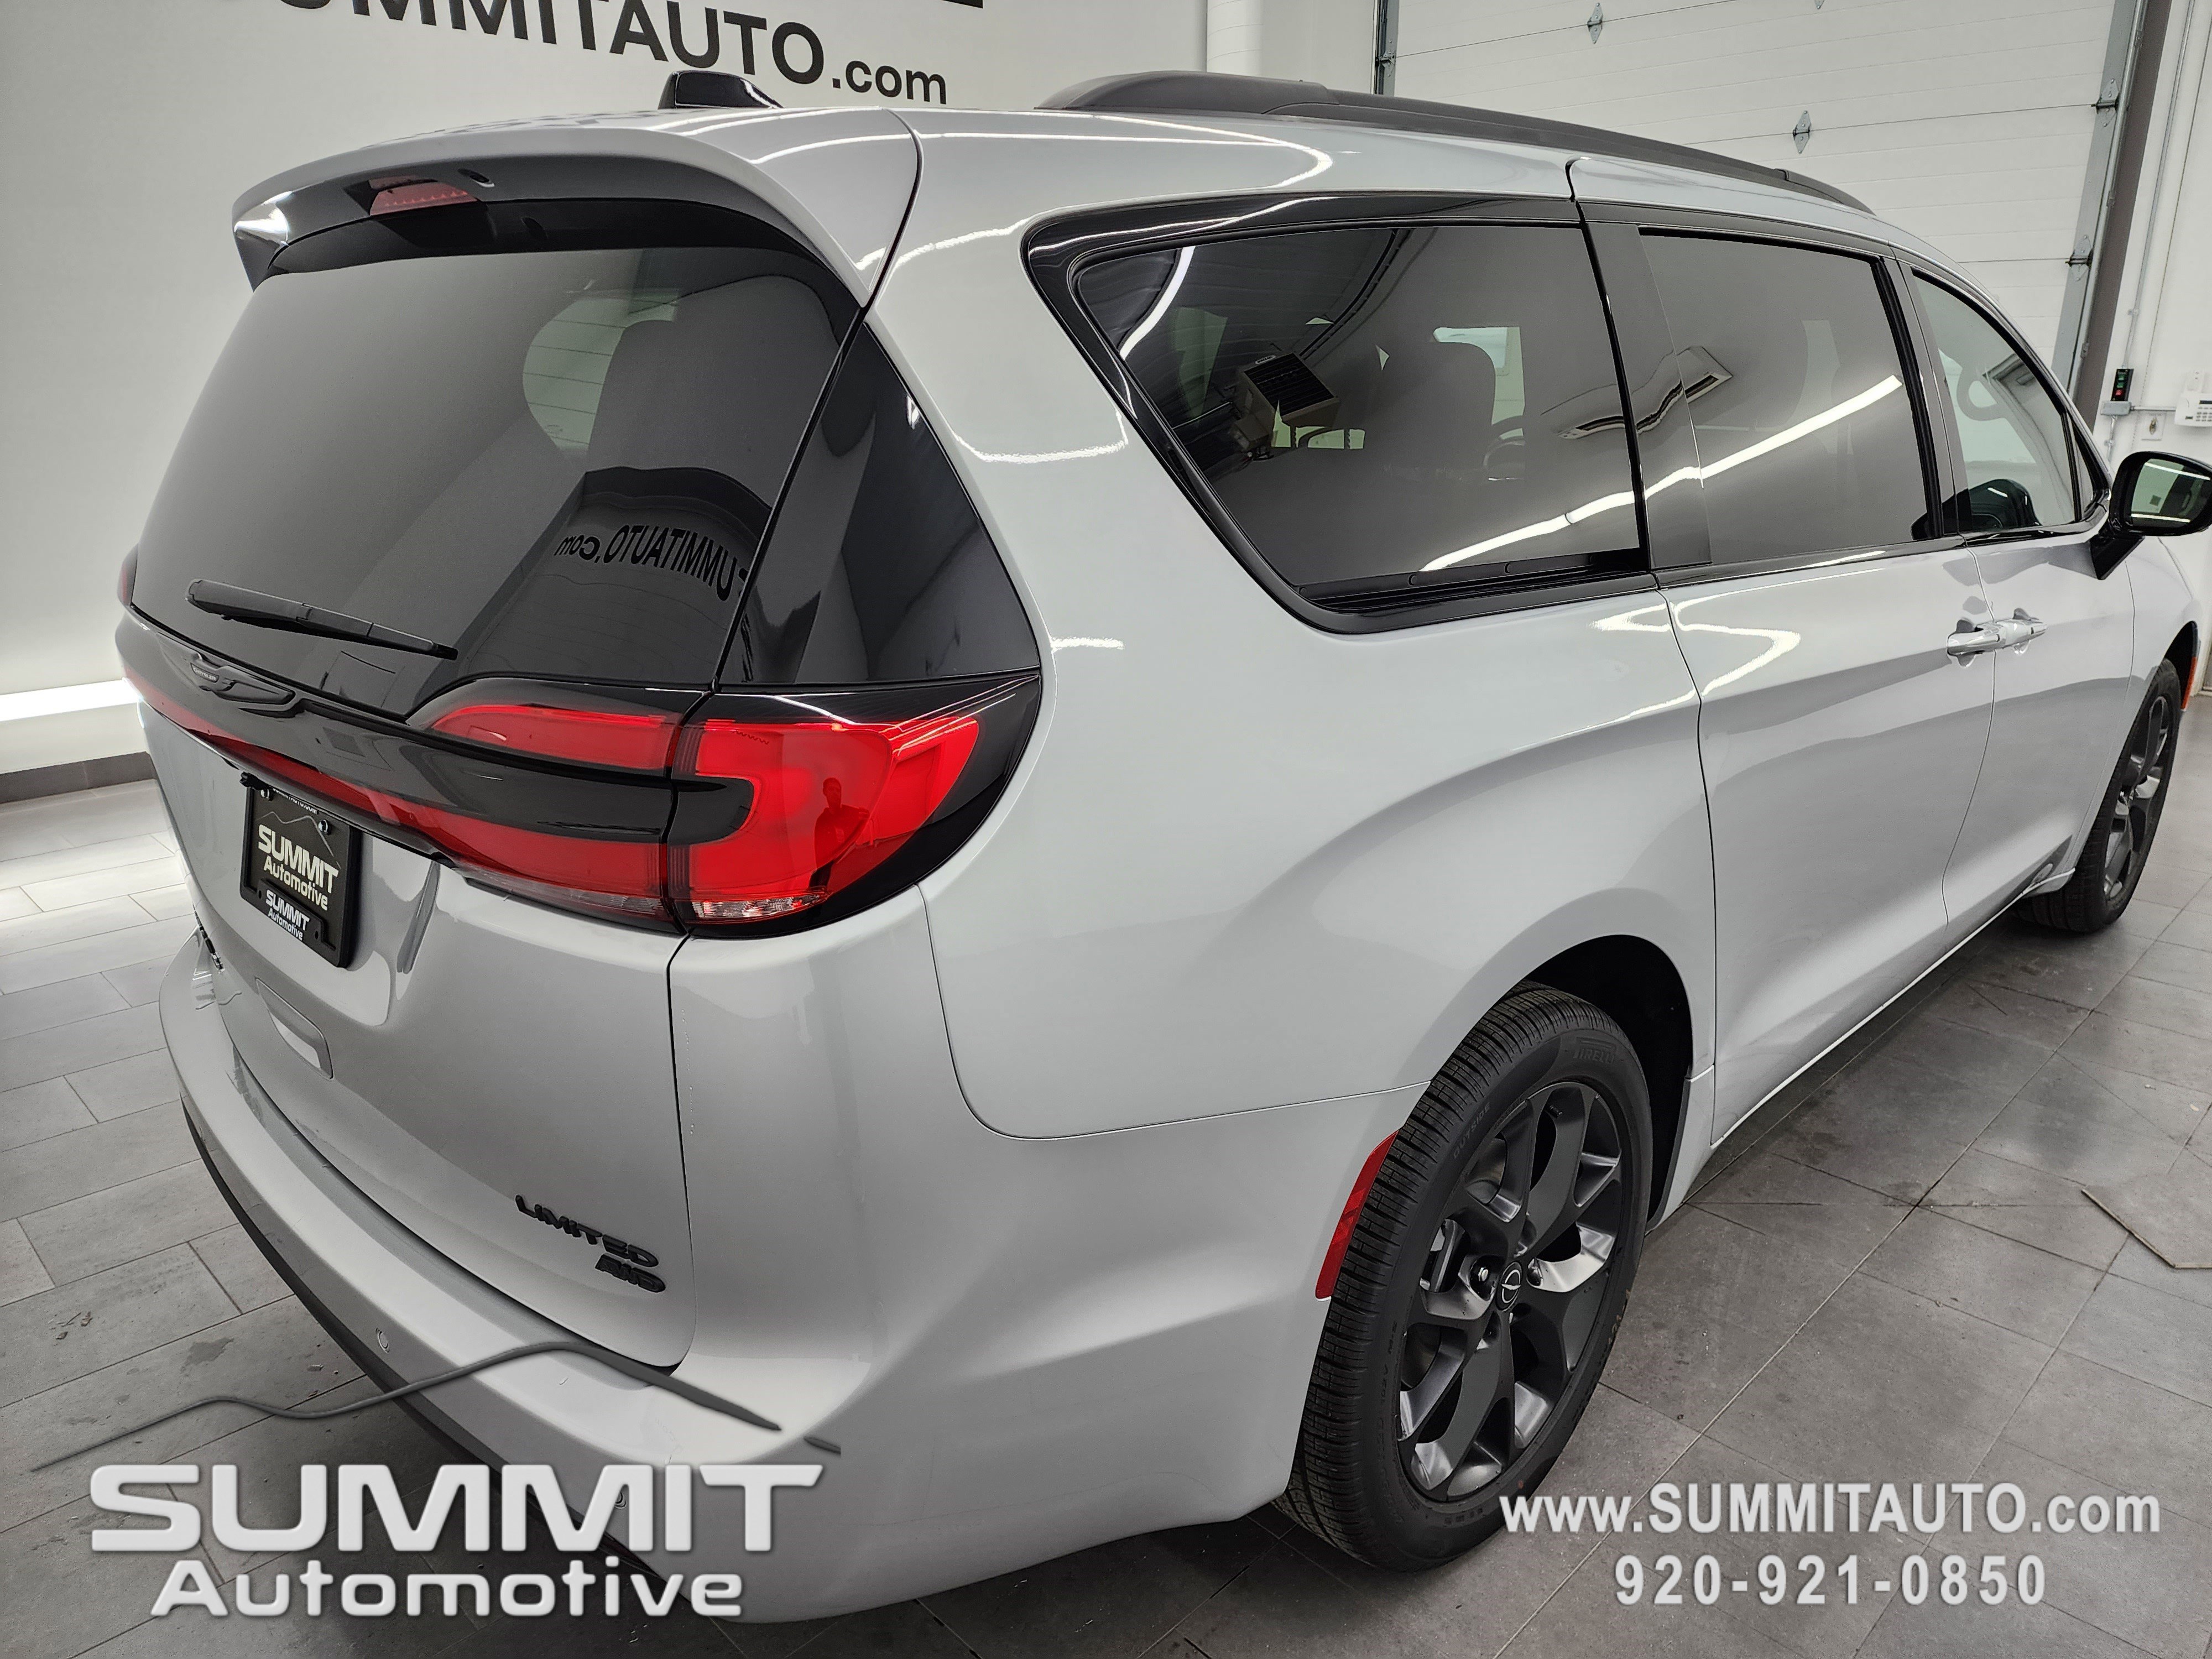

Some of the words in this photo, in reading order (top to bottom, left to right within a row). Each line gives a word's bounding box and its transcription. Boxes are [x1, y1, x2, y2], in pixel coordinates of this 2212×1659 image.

[258, 824, 339, 894] SUMMIT
[263, 855, 328, 911] Automotive
[265, 889, 310, 931] SUMMIT
[268, 907, 303, 941] Automotive
[1573, 1036, 1616, 1064] PIRELLI
[1453, 1102, 1490, 1160] OUTSIDE
[515, 1194, 659, 1267] LIMITED
